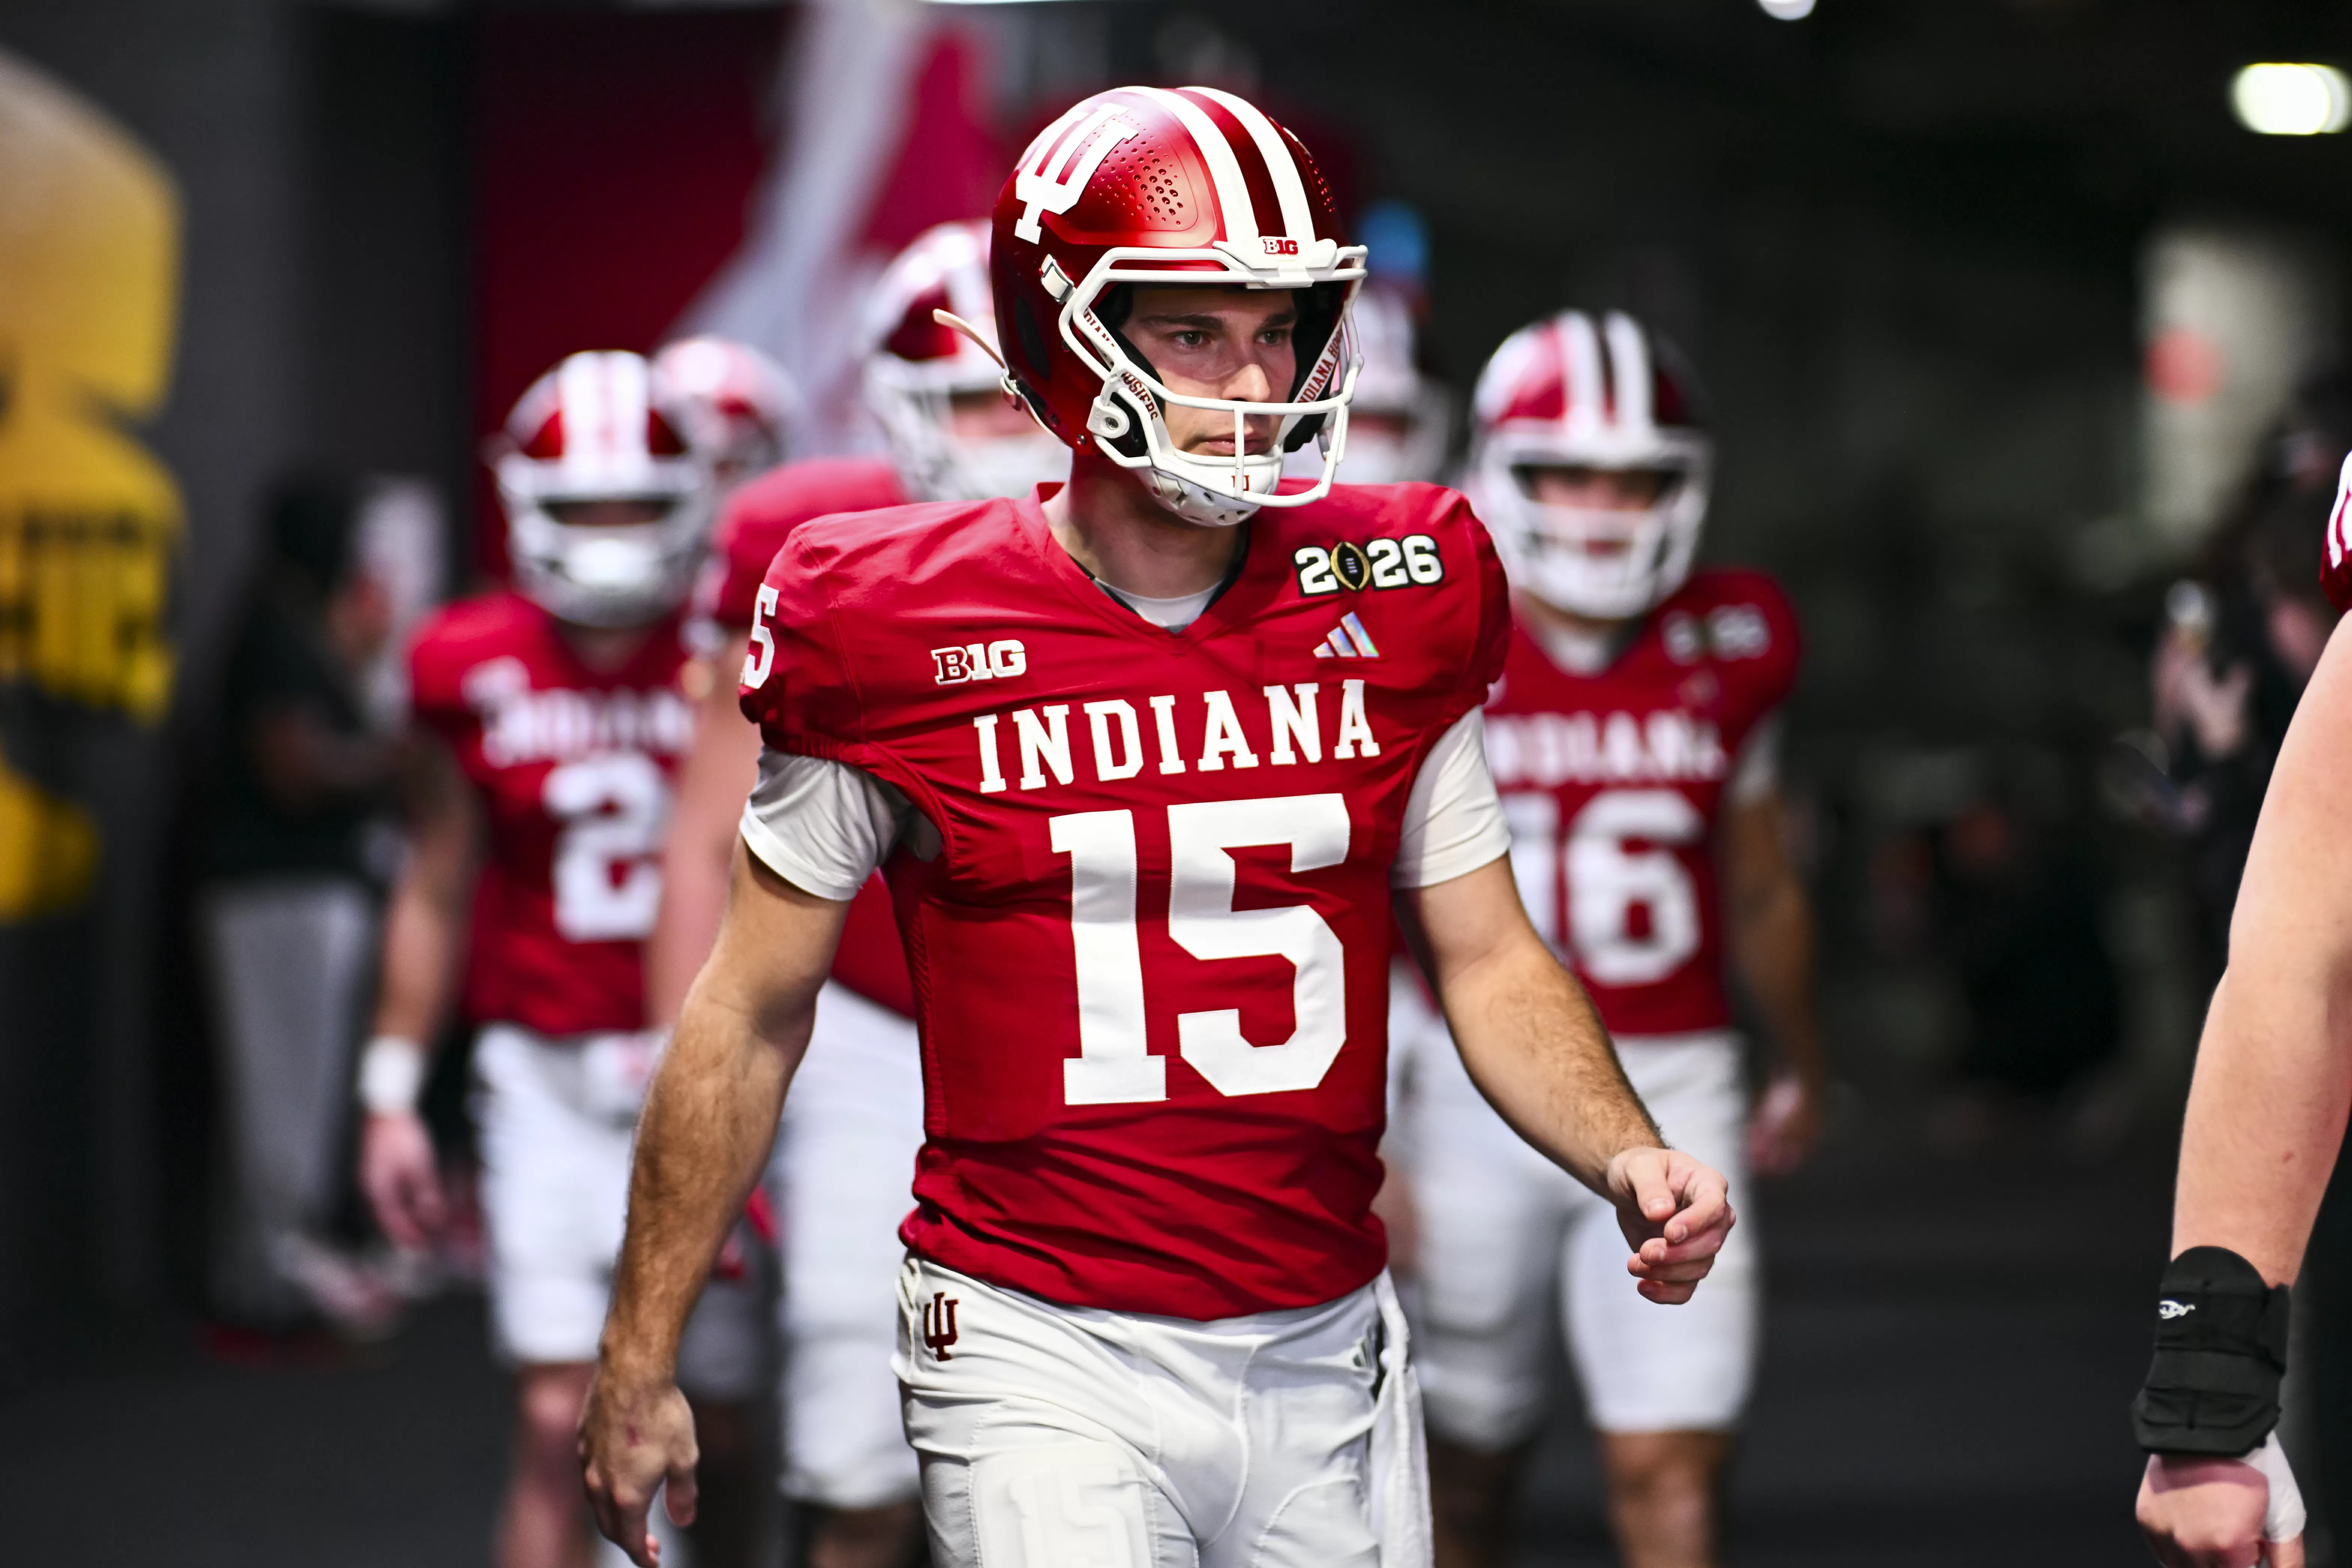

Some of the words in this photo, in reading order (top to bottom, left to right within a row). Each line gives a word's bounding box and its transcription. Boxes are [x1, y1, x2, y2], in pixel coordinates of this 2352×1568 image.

[1298, 358, 1334, 403] NDIANA
[974, 679, 1380, 793] INDIANA
[1049, 794, 1351, 1106] 15
